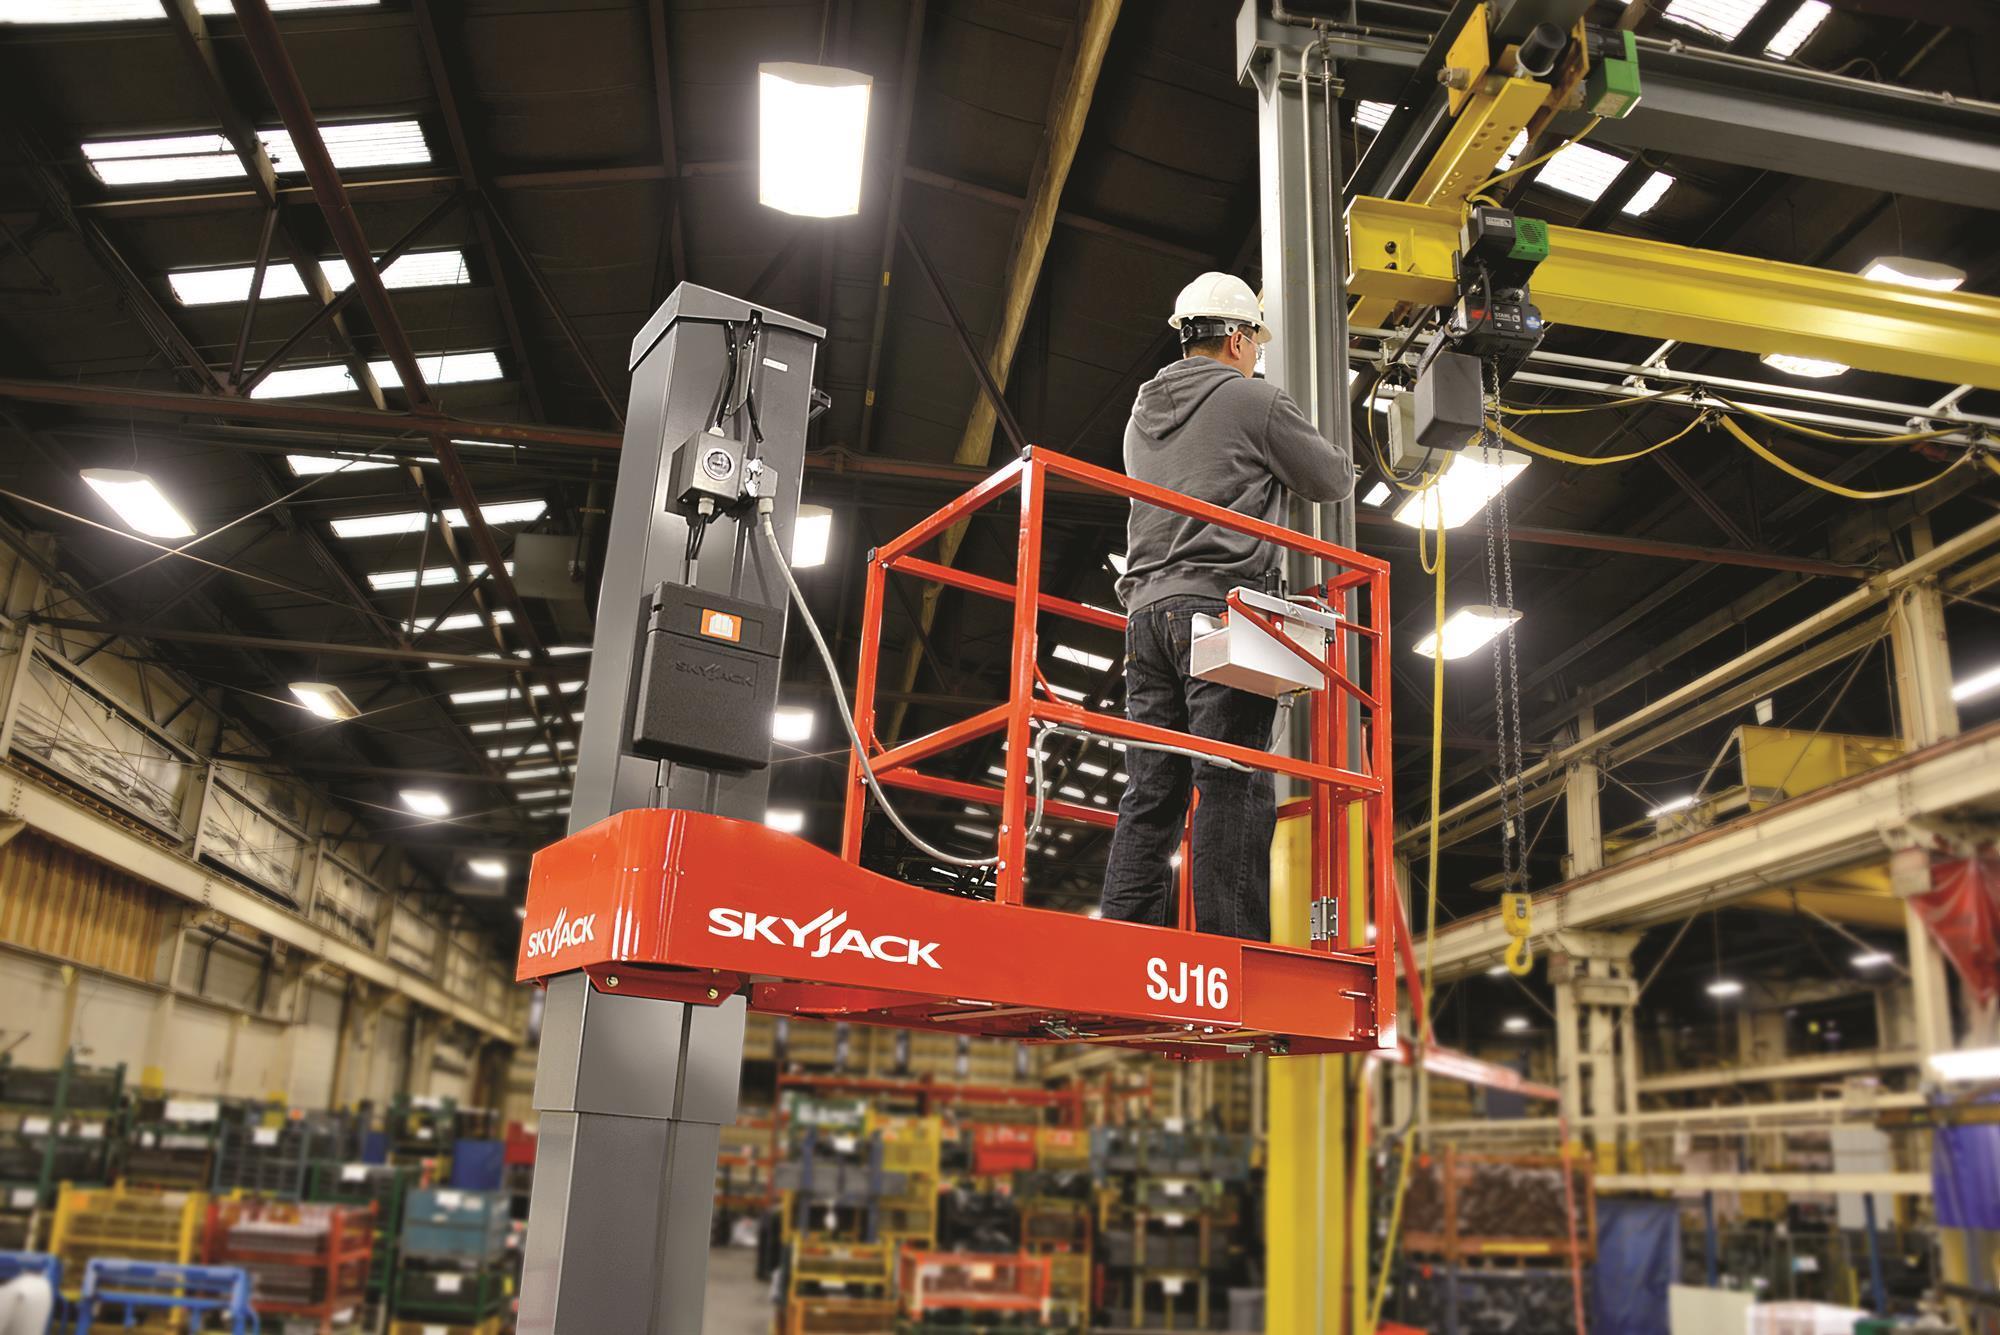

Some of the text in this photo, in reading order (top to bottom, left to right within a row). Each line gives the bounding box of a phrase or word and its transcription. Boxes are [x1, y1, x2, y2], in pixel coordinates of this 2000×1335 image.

[675, 663, 754, 687] SKYJACK
[527, 907, 596, 958] SKYJACK
[708, 907, 943, 969] SKYJACK
[1146, 957, 1229, 1010] SJ16
